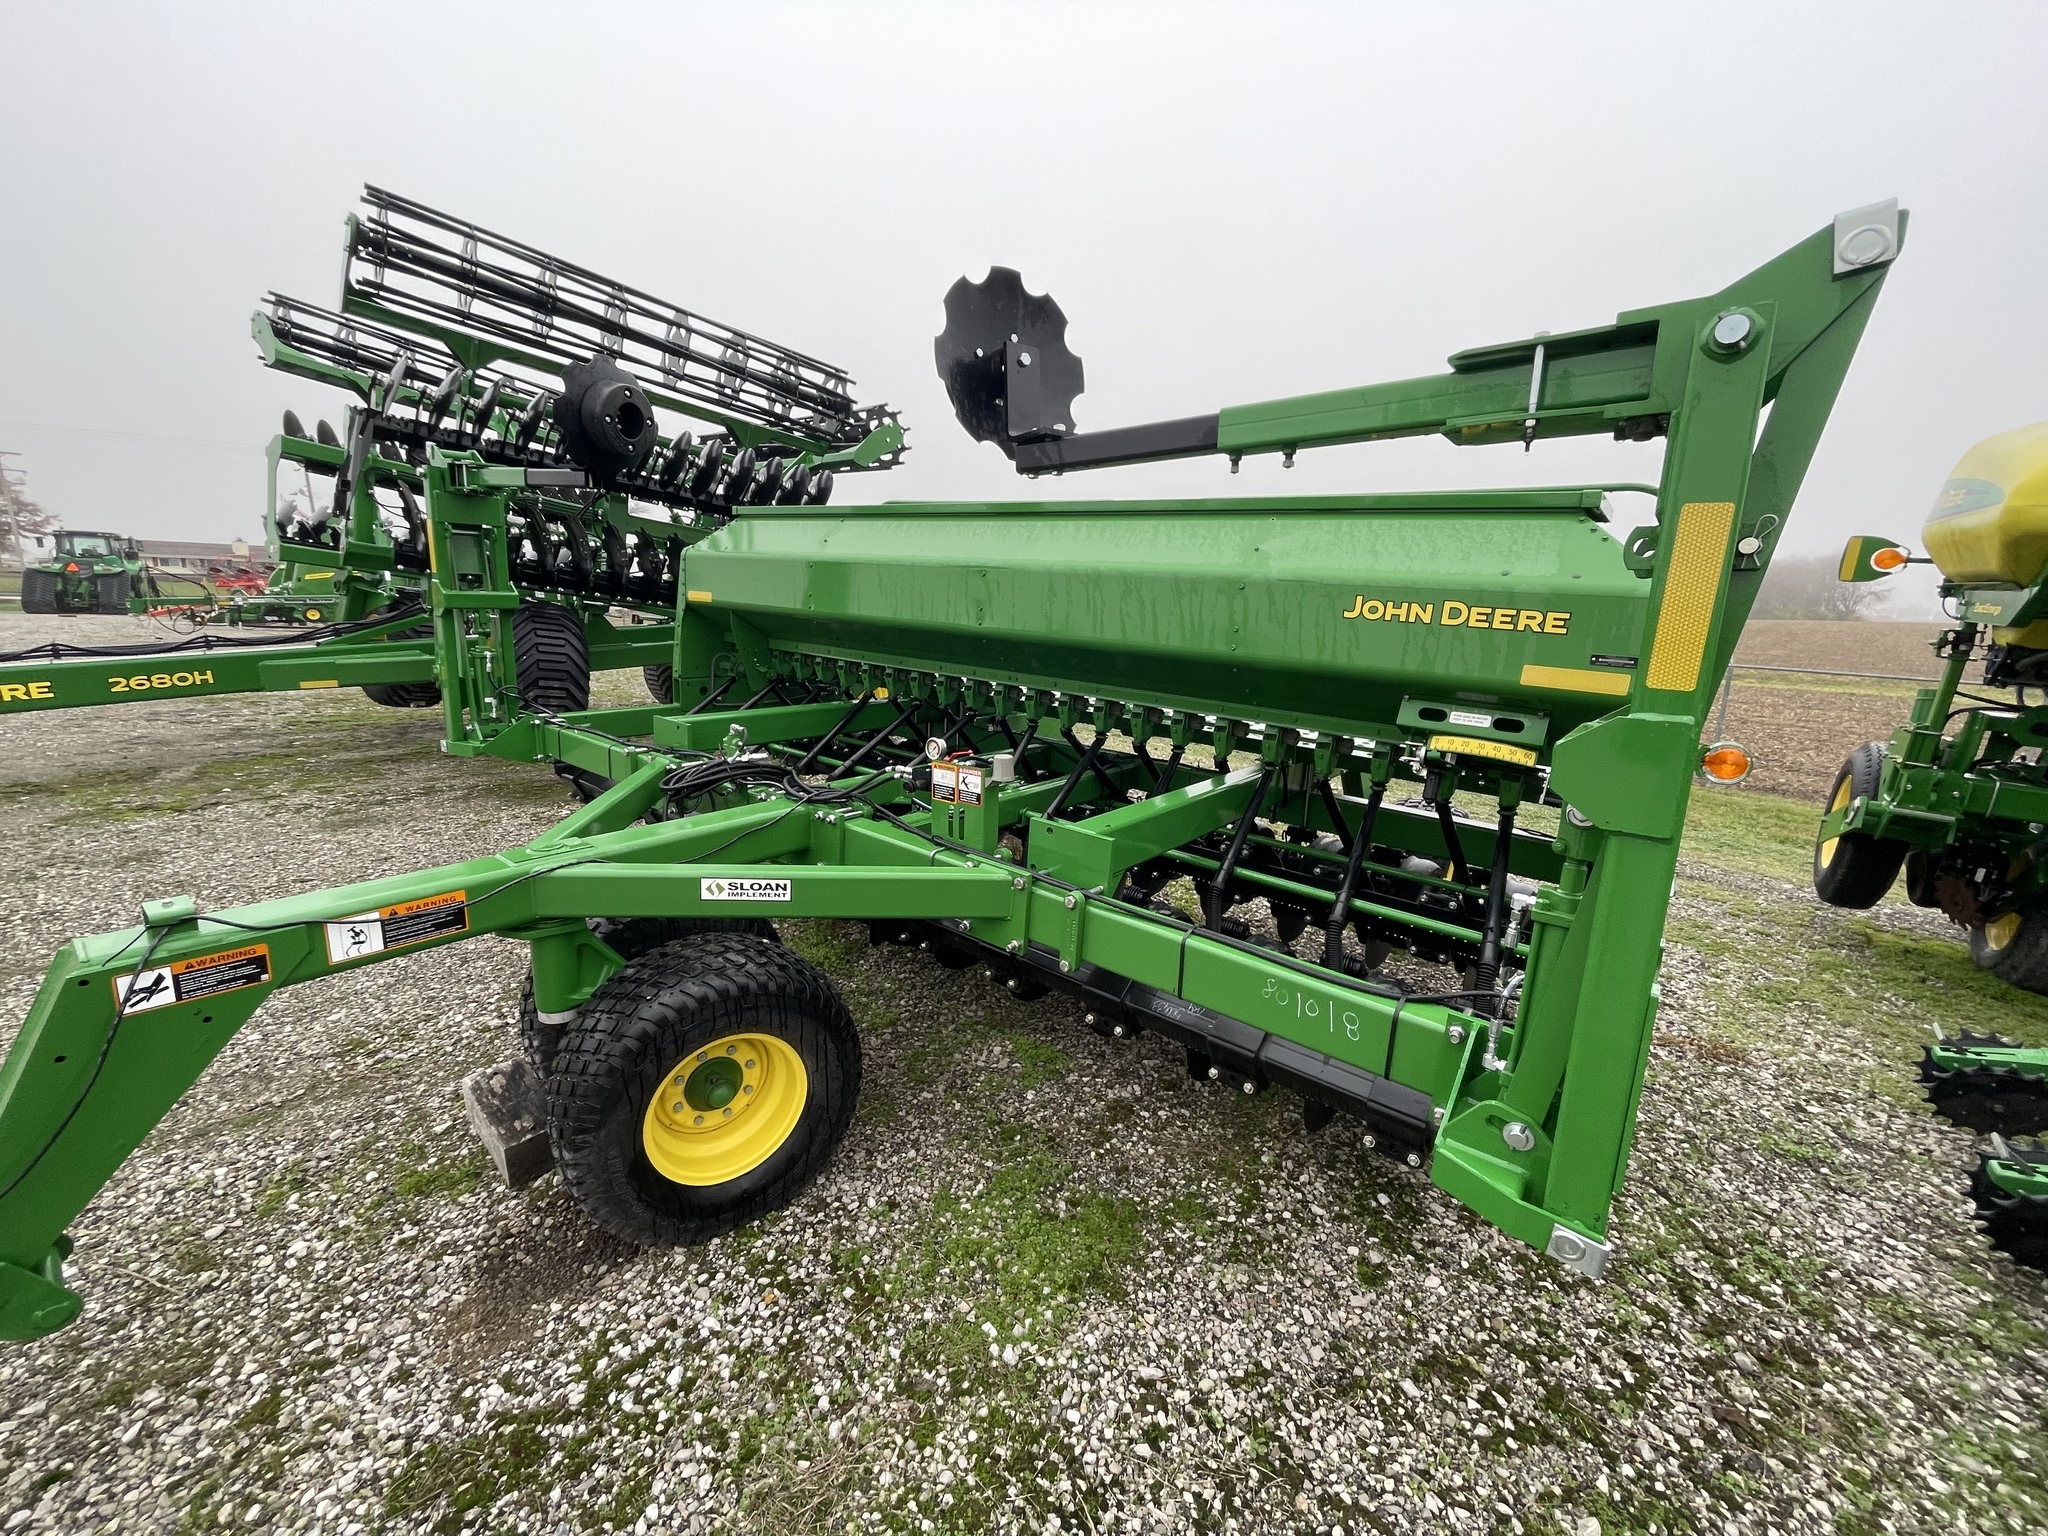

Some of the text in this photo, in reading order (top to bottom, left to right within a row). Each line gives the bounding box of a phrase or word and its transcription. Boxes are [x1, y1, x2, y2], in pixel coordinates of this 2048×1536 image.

[1343, 594, 1571, 635] JOHN DEERE
[107, 669, 215, 693] 2680H
[1461, 740, 1470, 748] 20
[1476, 742, 1486, 750] 30
[1492, 745, 1502, 753] 40
[1508, 748, 1518, 757] 50
[1523, 753, 1533, 761] 60
[727, 882, 788, 892] SLOAN
[405, 895, 458, 913] WARNING
[195, 948, 257, 968] WARNING
